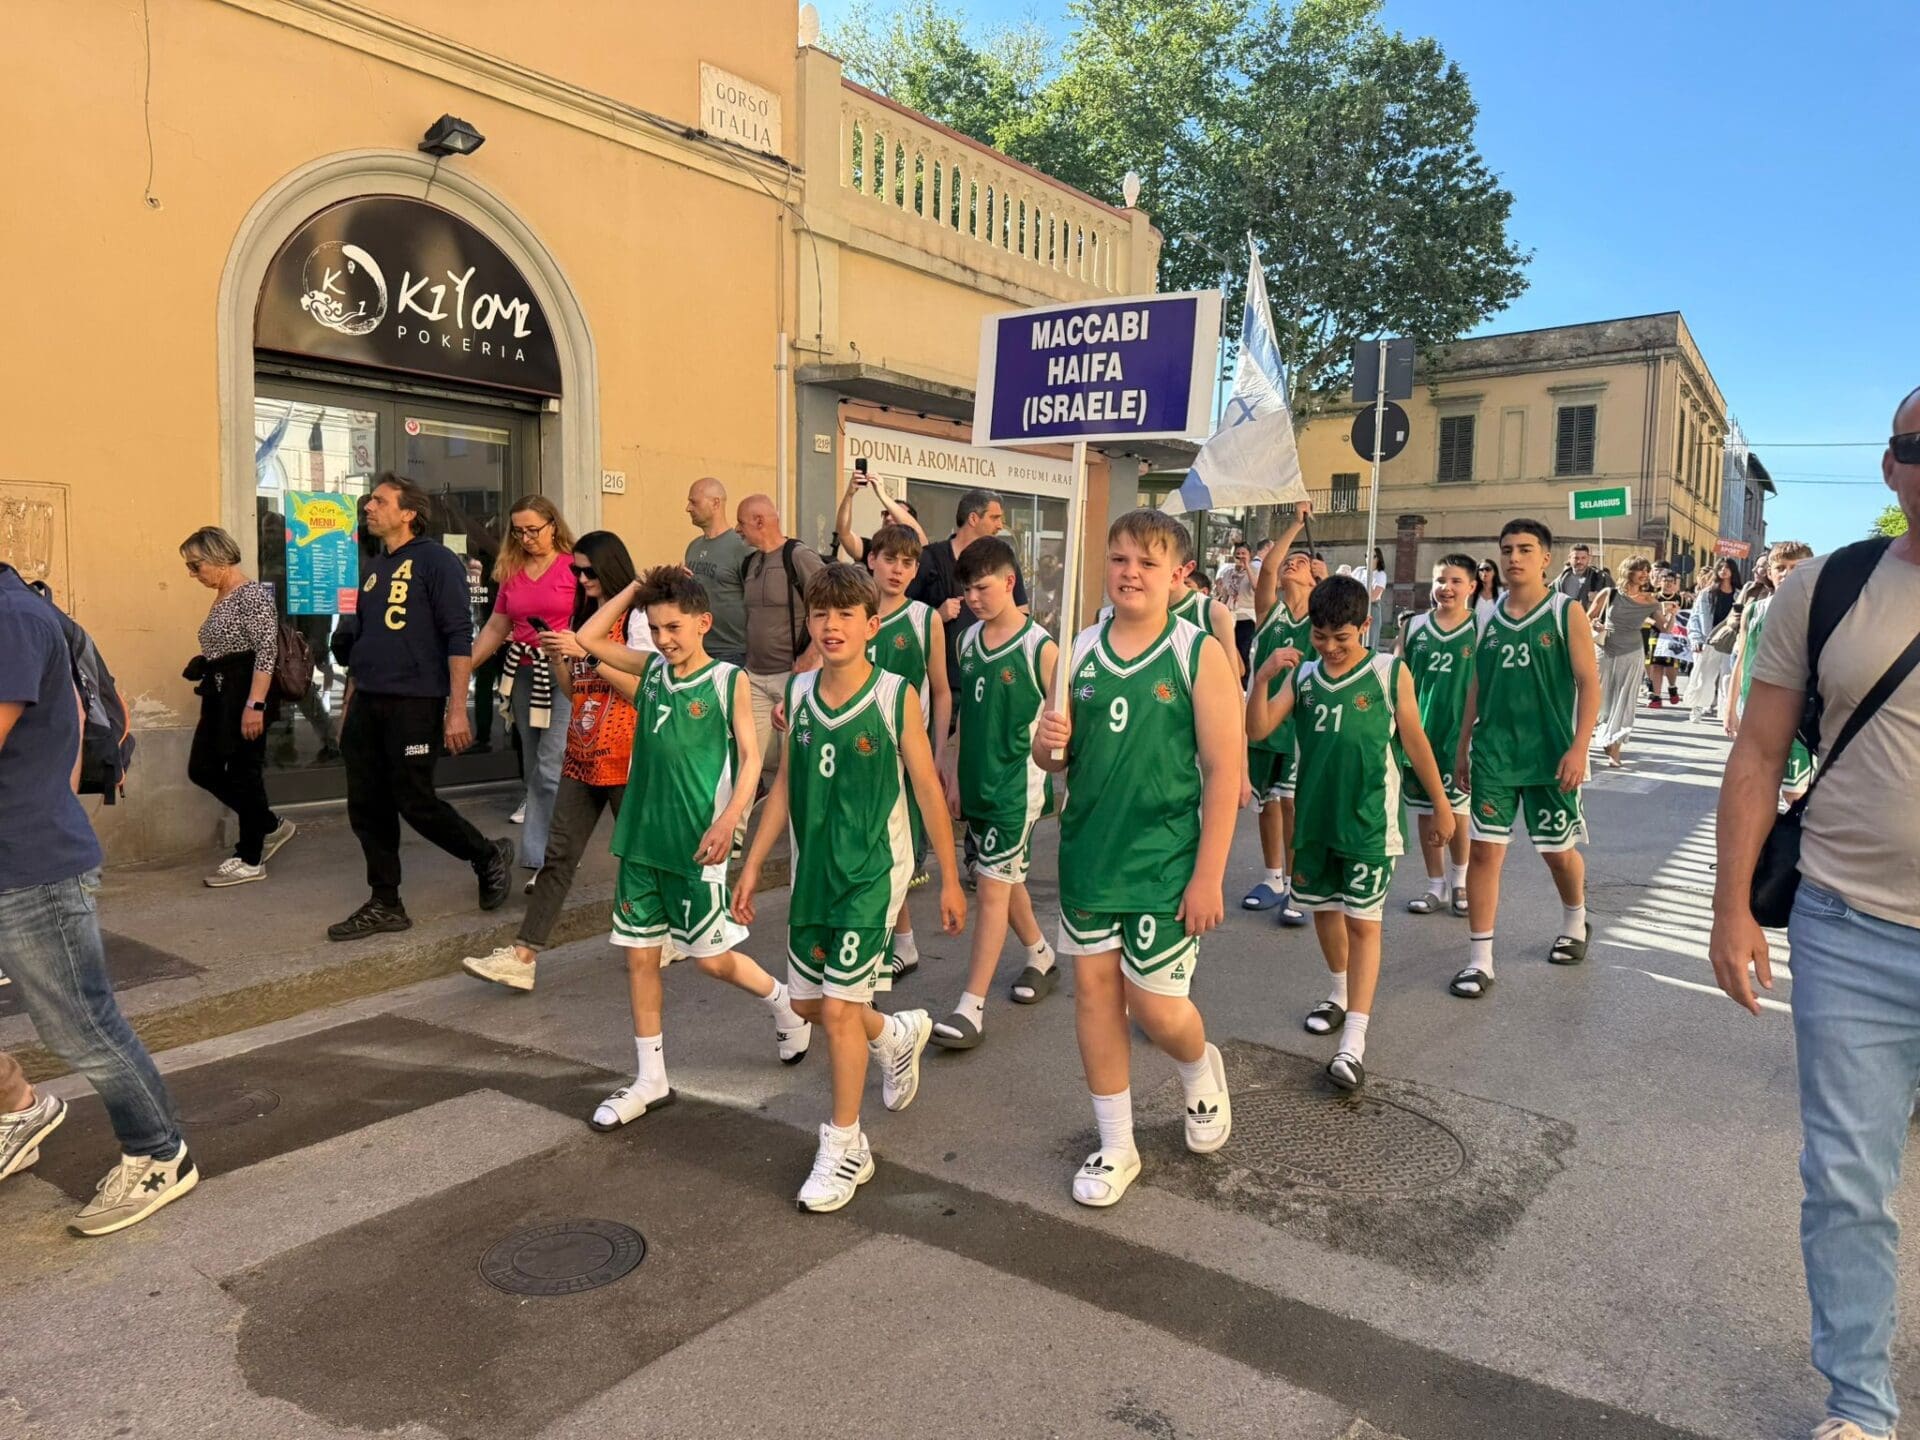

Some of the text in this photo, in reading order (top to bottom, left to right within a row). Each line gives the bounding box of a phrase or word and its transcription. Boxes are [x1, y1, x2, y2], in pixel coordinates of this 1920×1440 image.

[716, 82, 769, 117] CORSO
[711, 106, 771, 148] ITALIA
[398, 325, 525, 362] POKERIA
[1031, 310, 1150, 350] MACCABI
[1047, 352, 1123, 386] HAIFA
[1022, 389, 1148, 431] (ISRAELE)
[850, 438, 913, 465] DOUNIA
[917, 449, 997, 477] AROMATICA
[1008, 466, 1048, 482] PROFUMI
[605, 474, 624, 489] 216
[1579, 498, 1620, 509] SELARGIUS
[309, 516, 336, 527] MENU
[1428, 651, 1454, 673] 22
[1501, 643, 1531, 668] 23
[1079, 670, 1098, 678] PEAK
[975, 676, 985, 703] 6
[653, 703, 673, 733] 7
[1109, 696, 1129, 732] 9
[1314, 703, 1343, 732] 21
[819, 743, 836, 778] 8
[1538, 808, 1567, 832] 23
[984, 826, 998, 852] 6
[1350, 863, 1383, 894] 21
[682, 899, 691, 929] 7
[1136, 914, 1156, 950] 9
[839, 931, 860, 967] 8
